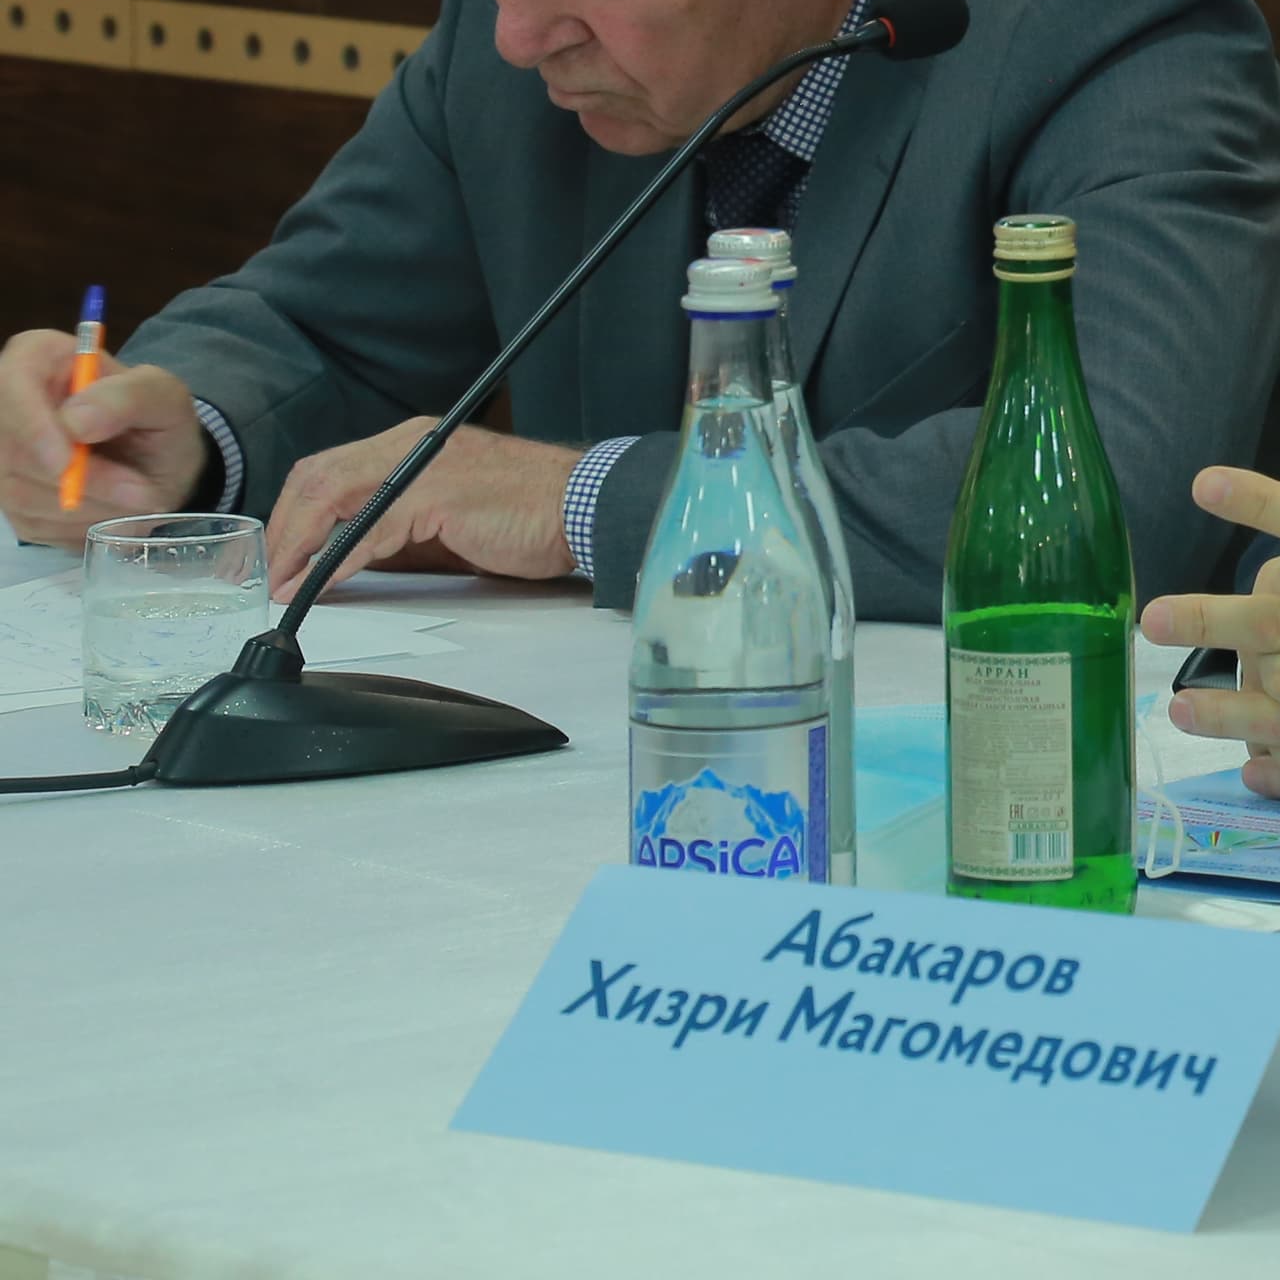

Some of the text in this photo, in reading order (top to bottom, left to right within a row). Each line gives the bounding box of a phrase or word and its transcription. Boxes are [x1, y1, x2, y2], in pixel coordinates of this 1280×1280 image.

[762, 908, 1082, 1008] Абакаров
[559, 958, 1219, 1098] Хизри Магомедович
